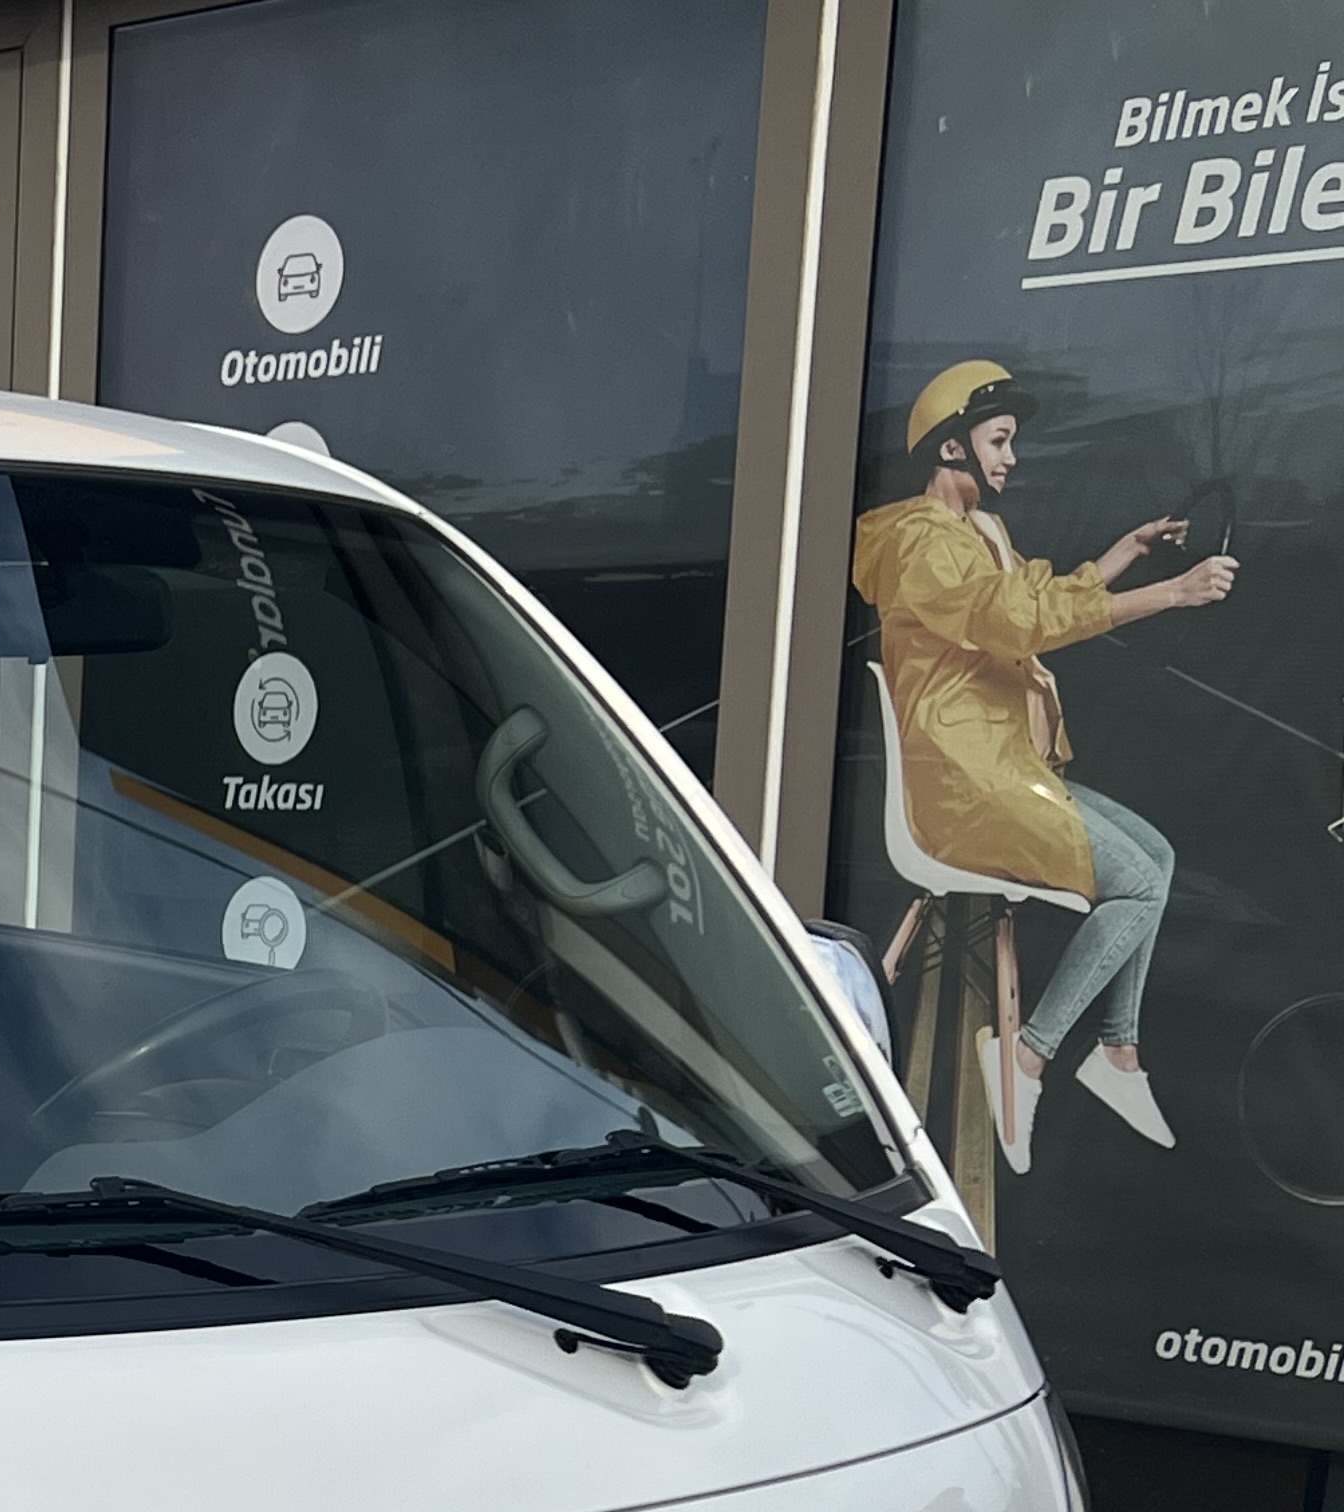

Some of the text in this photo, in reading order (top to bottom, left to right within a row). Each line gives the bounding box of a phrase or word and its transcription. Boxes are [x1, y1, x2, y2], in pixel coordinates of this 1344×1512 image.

[1114, 76, 1299, 148] Bilmek
[1027, 145, 1344, 260] Bir Bile
[220, 335, 383, 387] Otomobili
[222, 774, 324, 811] Takası
[1155, 1328, 1344, 1383] otomobi
